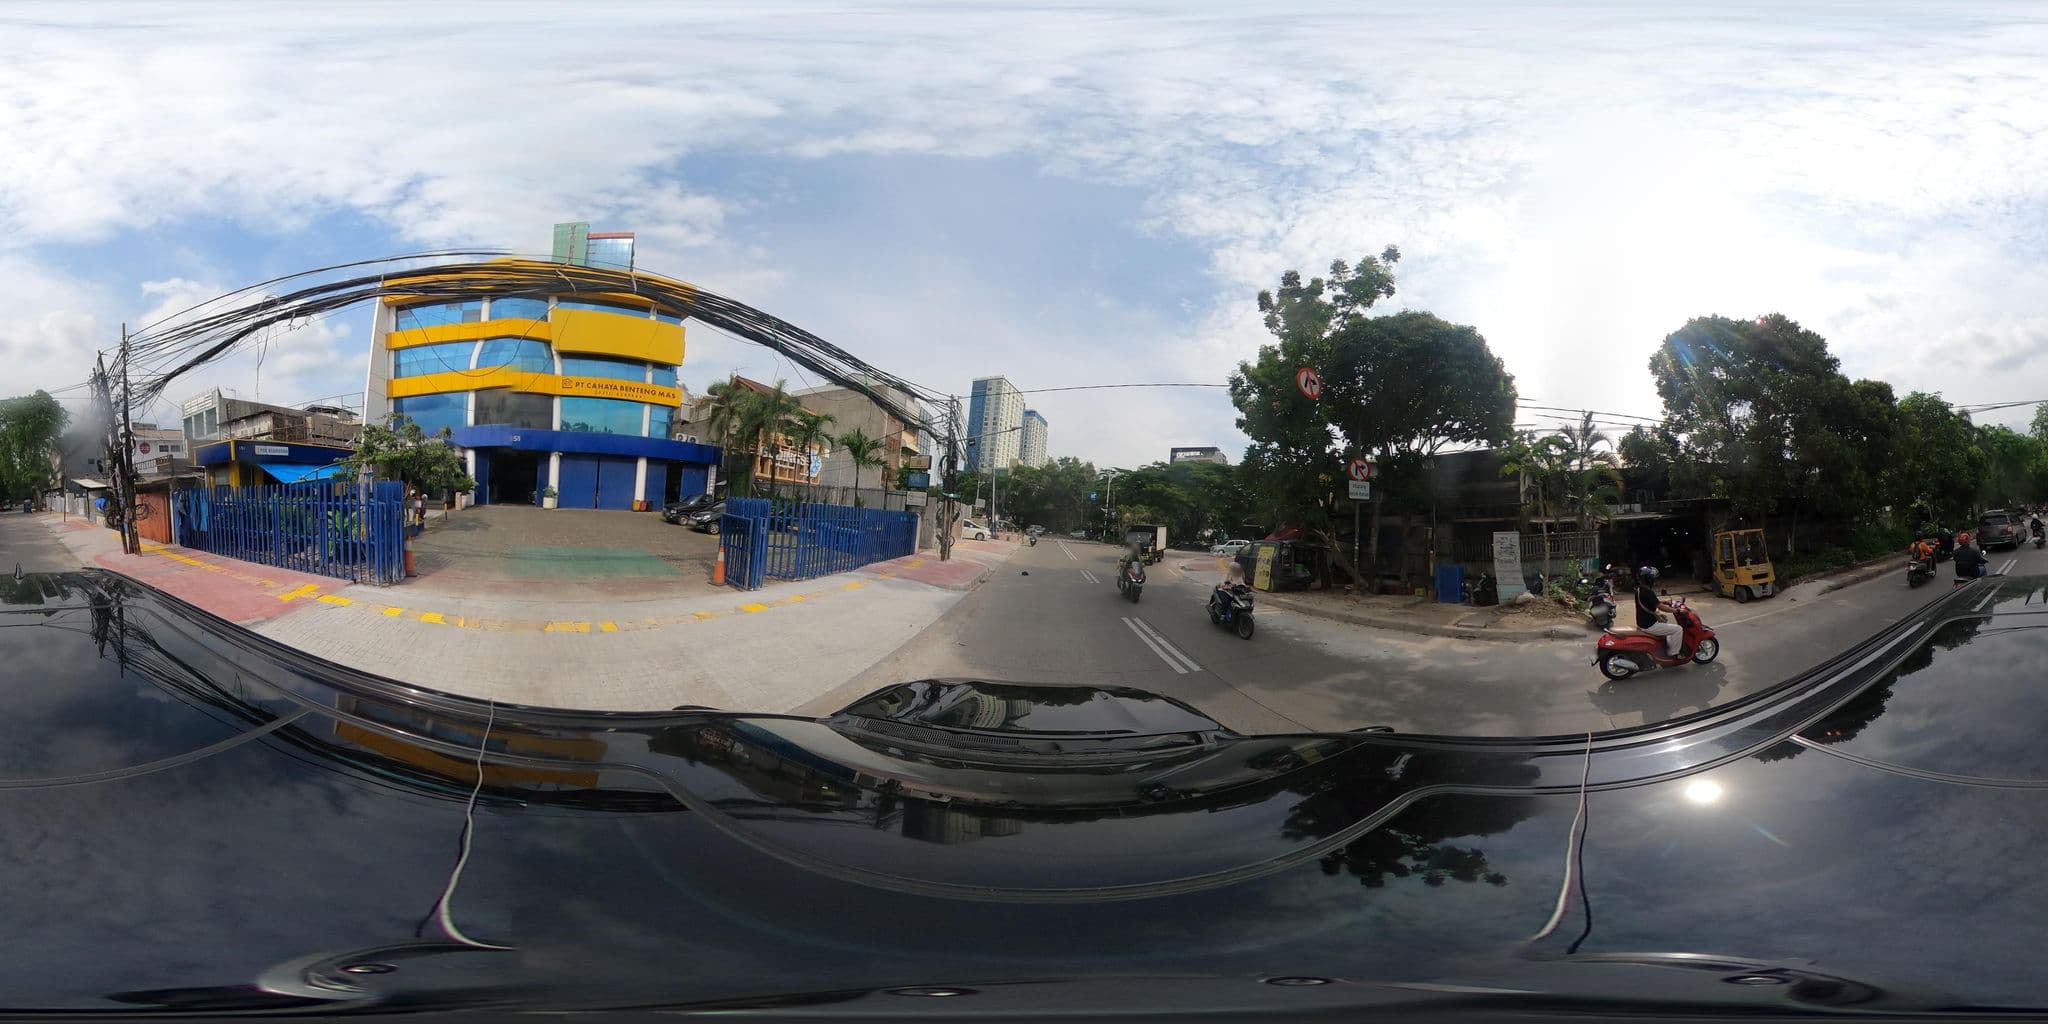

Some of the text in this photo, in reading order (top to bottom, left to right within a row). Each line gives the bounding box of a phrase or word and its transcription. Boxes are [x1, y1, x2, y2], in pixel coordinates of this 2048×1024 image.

[586, 382, 617, 391] CAHAYA
[619, 385, 656, 395] BENTENG
[658, 391, 676, 399] MAS
